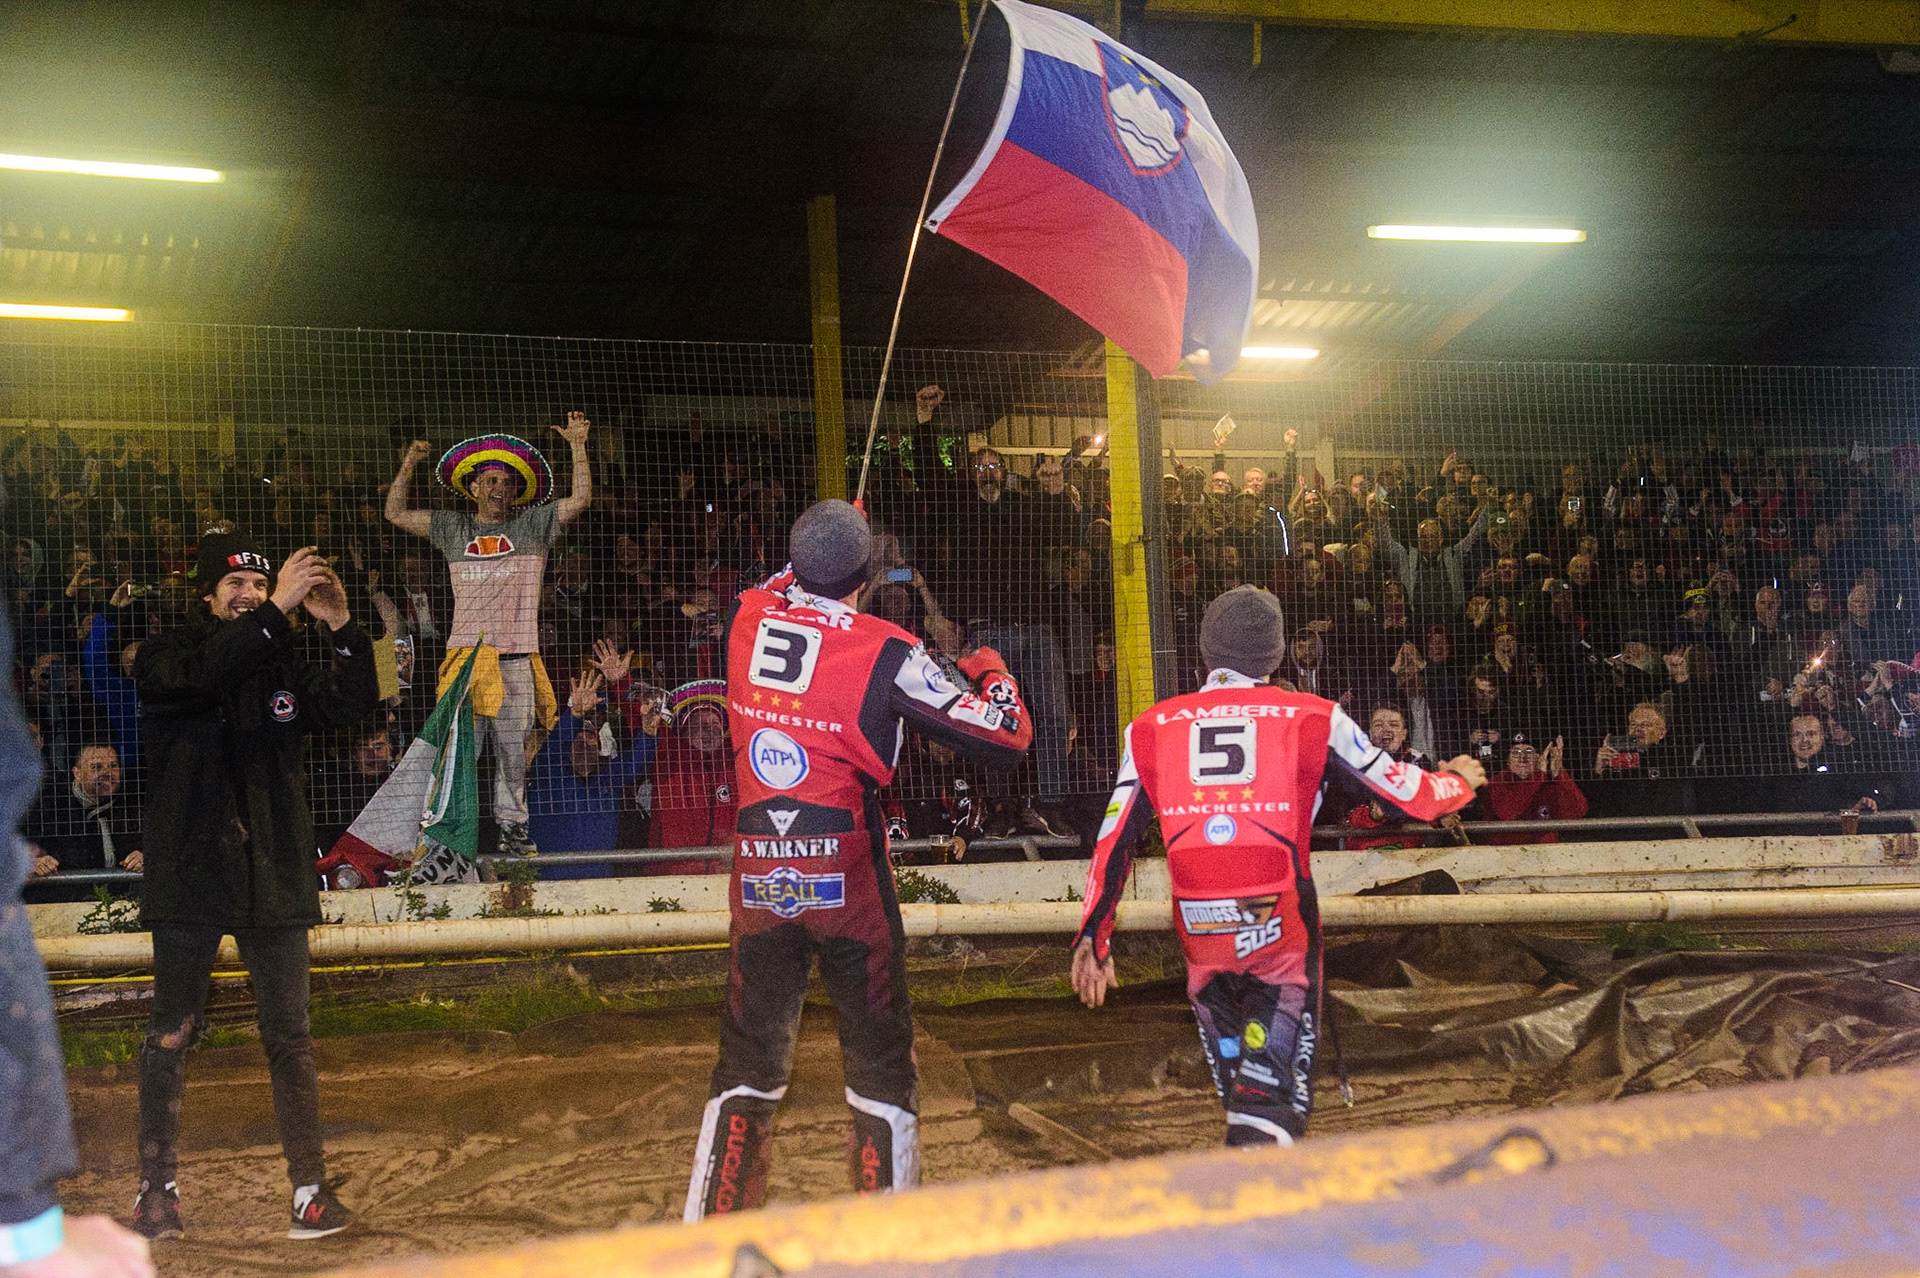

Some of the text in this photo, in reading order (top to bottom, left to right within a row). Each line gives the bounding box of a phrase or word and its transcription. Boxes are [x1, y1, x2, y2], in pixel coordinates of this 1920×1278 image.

[759, 628, 808, 683] 3
[1156, 705, 1300, 725] LAMBERT
[760, 748, 797, 766] ATPI
[1200, 725, 1245, 776] 5
[1162, 802, 1290, 816] MANCHESTER
[754, 883, 822, 902] REALL
